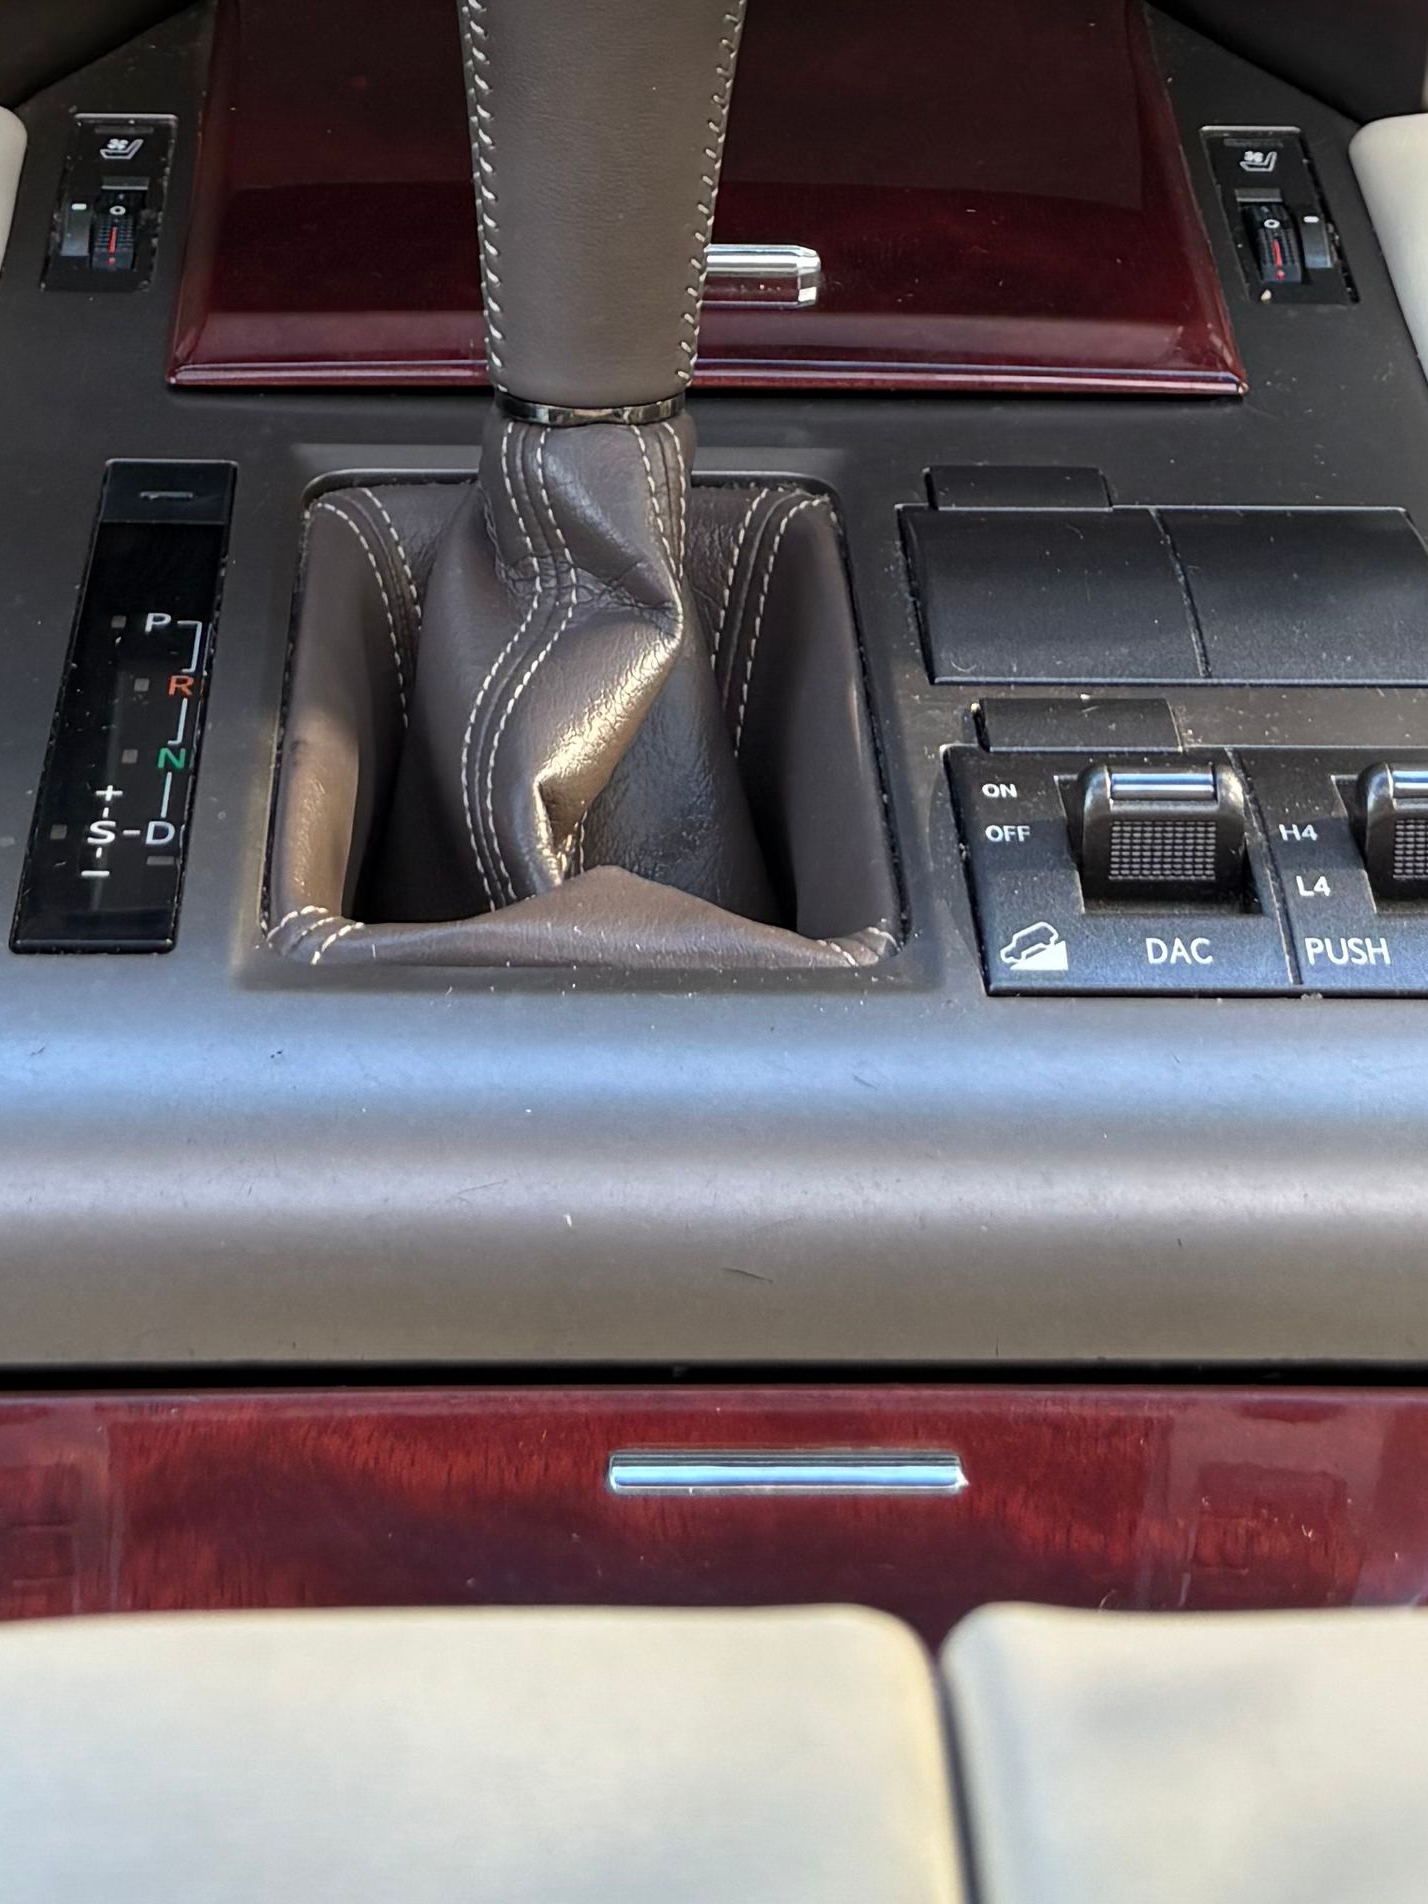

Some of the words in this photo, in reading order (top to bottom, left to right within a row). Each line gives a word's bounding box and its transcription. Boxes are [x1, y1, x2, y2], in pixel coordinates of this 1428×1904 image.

[144, 612, 172, 633] P
[167, 675, 194, 696] R
[157, 747, 186, 769] N
[981, 783, 1018, 799] ON
[145, 820, 176, 845] D
[984, 824, 1030, 842] OFF
[1278, 823, 1318, 841] H4
[1295, 875, 1332, 897] L4
[1145, 937, 1214, 965] DAC
[1304, 937, 1391, 966] PUSH
